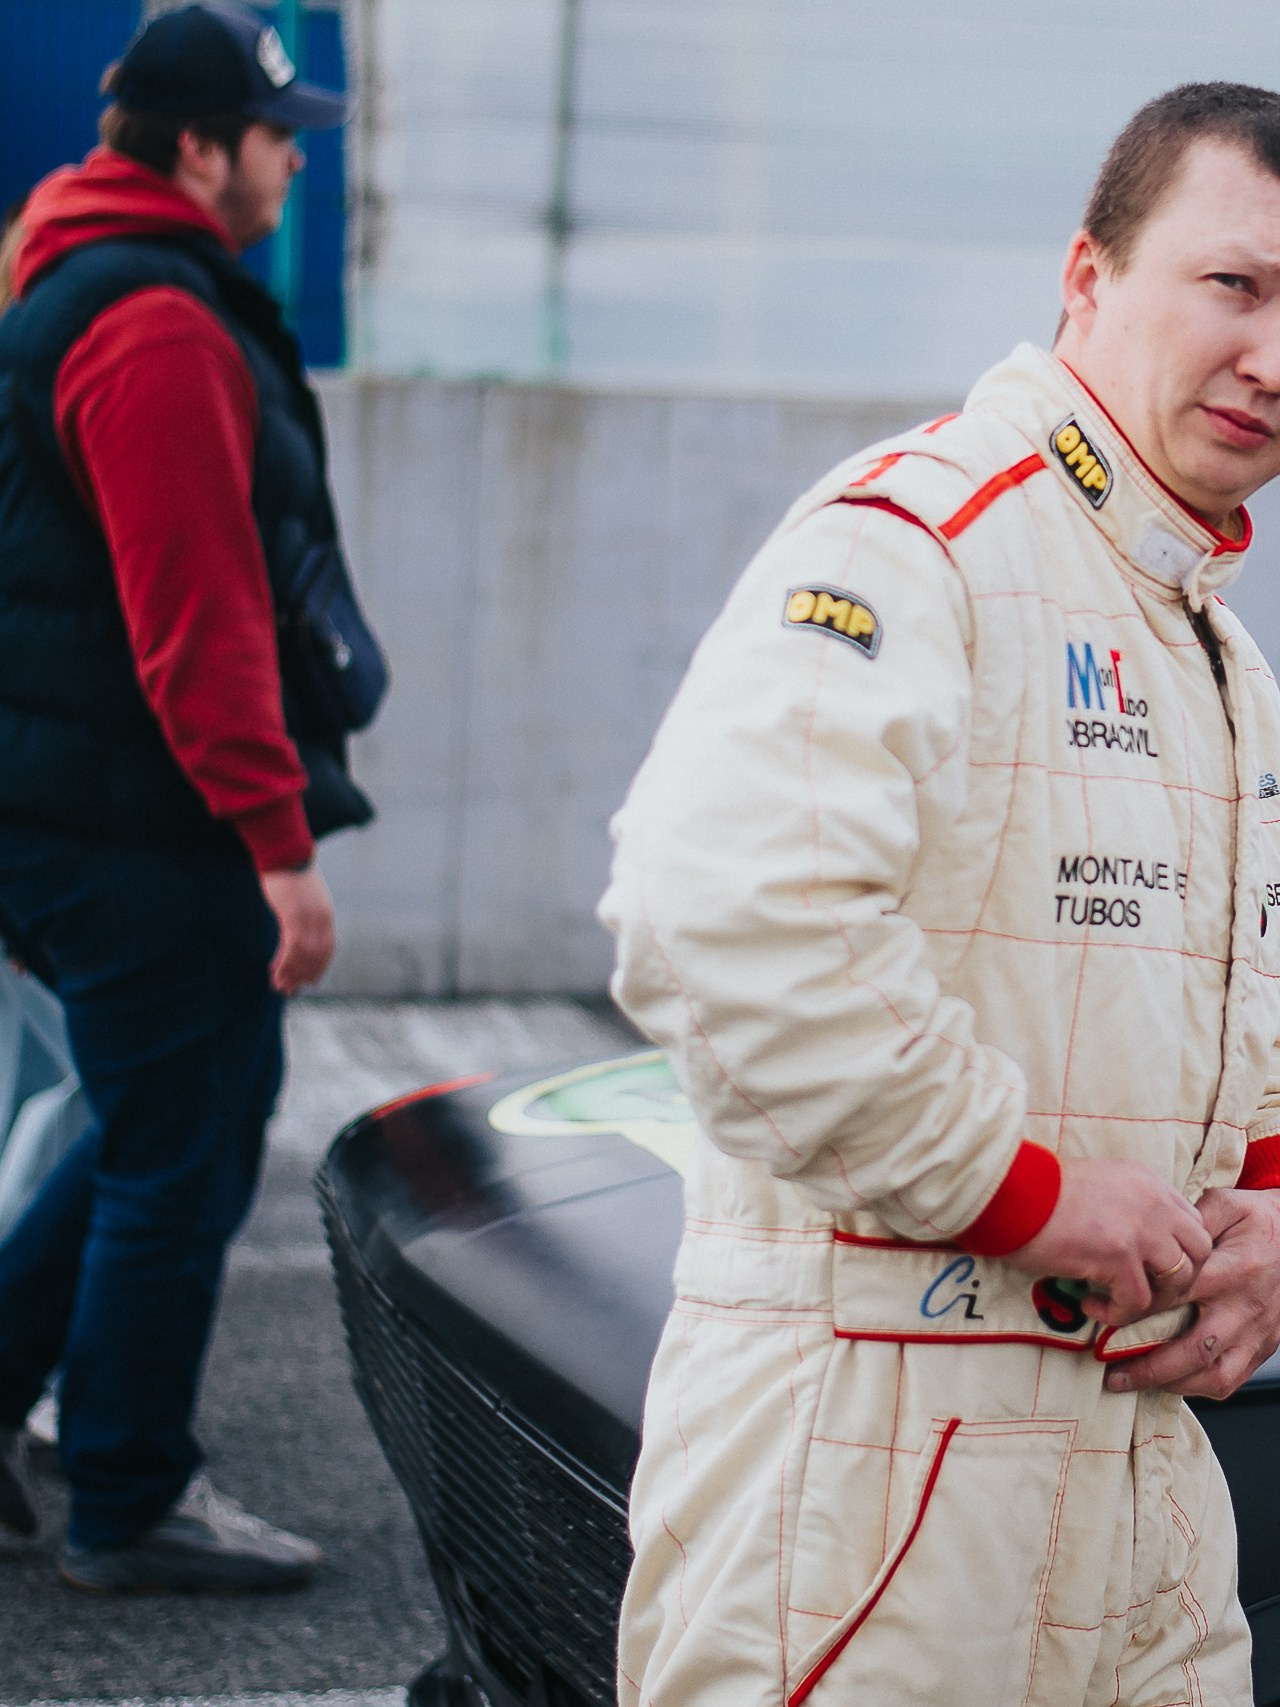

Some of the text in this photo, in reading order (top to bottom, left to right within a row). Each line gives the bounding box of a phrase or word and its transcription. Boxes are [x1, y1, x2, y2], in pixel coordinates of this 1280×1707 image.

[1055, 424, 1107, 490] OMP
[786, 590, 876, 638] OMP
[1057, 855, 1170, 890] MONTAJE
[1055, 894, 1141, 928] TUBOS
